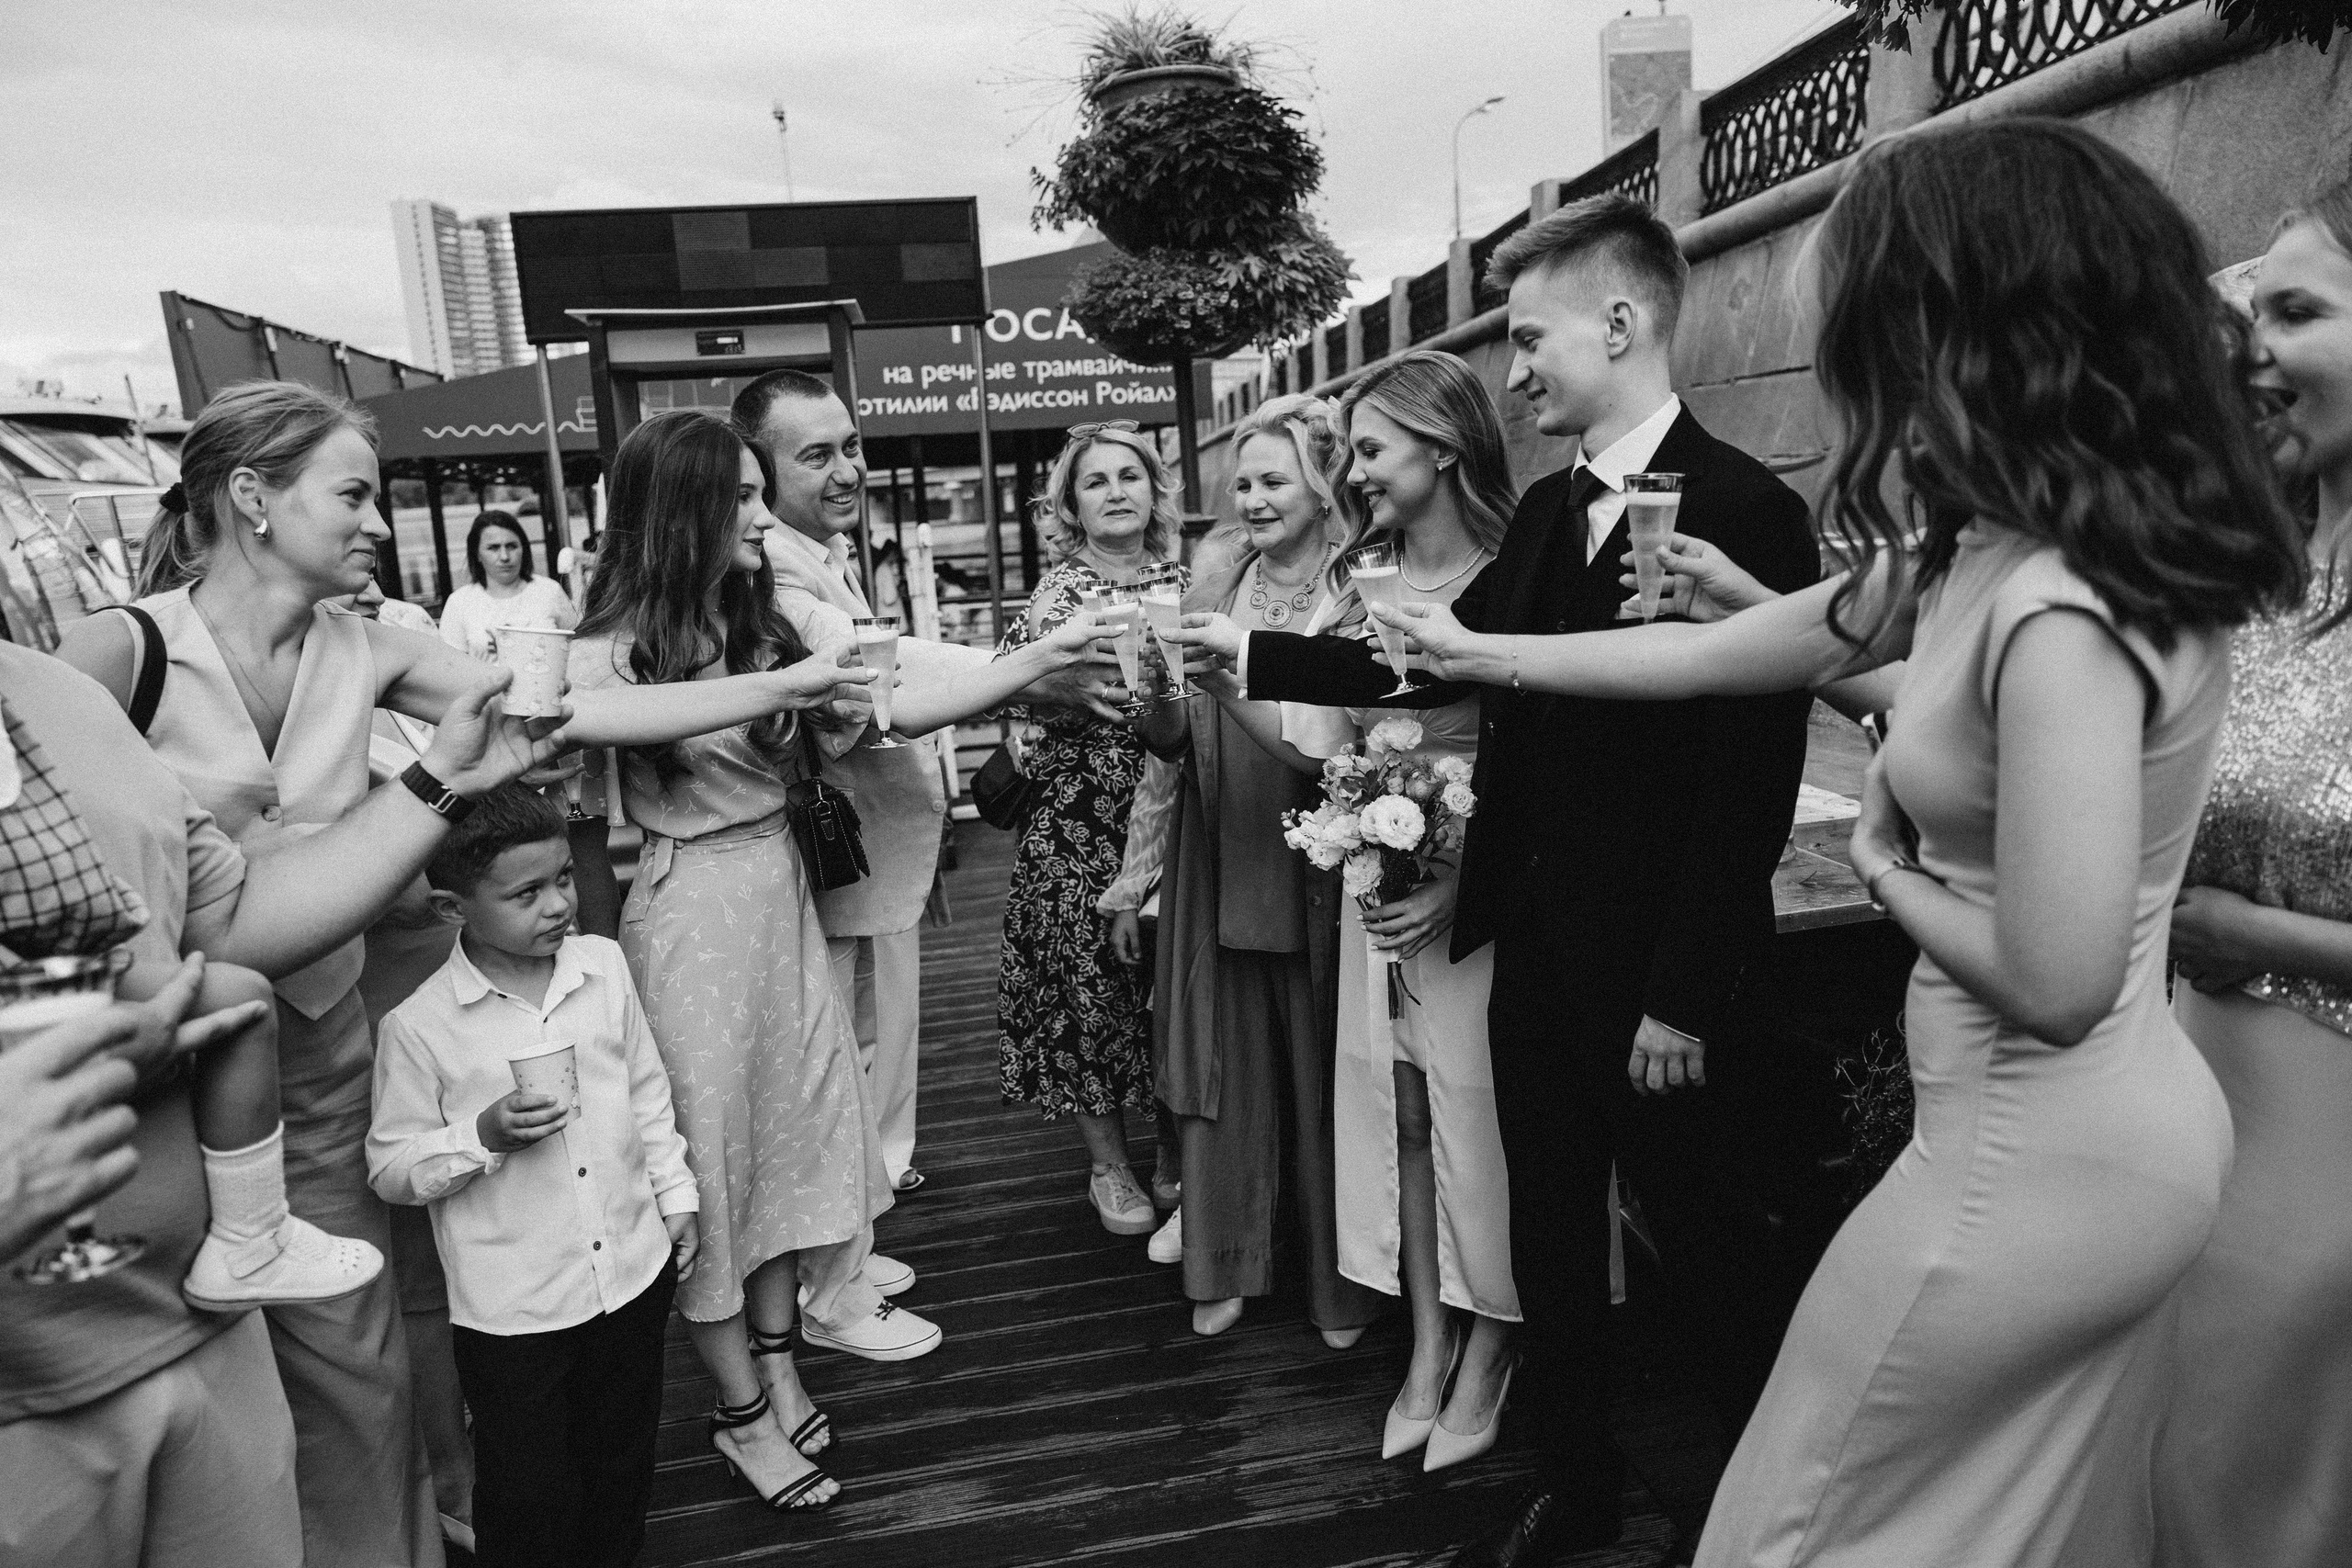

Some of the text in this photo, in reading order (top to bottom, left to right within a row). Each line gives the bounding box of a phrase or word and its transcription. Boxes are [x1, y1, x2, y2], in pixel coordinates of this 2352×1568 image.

[951, 307, 1096, 344] ОСА
[883, 366, 914, 384] на
[856, 395, 949, 416] отилии
